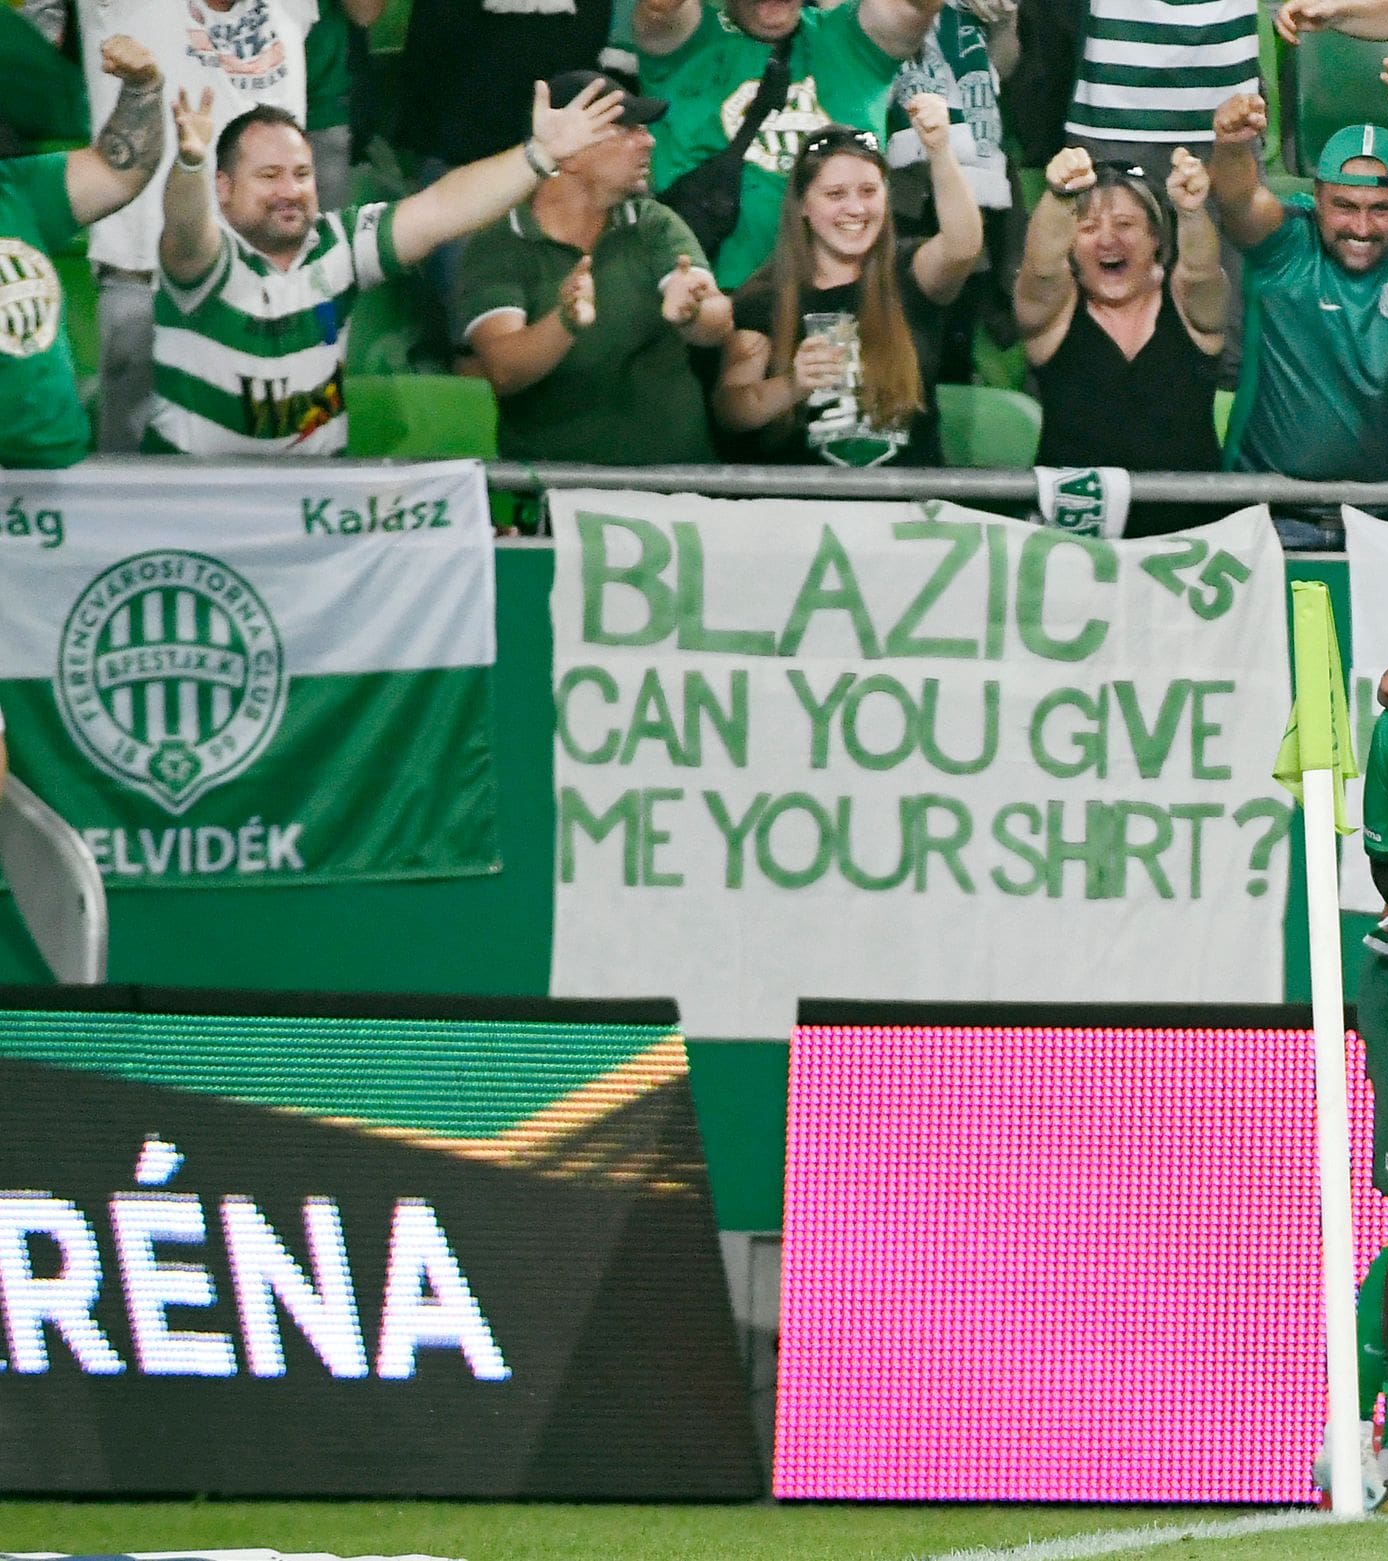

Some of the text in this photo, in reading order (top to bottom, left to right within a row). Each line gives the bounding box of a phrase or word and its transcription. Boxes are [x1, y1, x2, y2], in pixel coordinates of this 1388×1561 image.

[0, 495, 64, 549] ág
[302, 497, 451, 535] Kalász
[575, 500, 1119, 662] BLAŽIC
[1140, 536, 1252, 621] 25
[557, 666, 749, 769] CAN
[786, 670, 1000, 775] YOU
[1028, 679, 1235, 780] GIVE
[82, 816, 304, 875] ELVIDÉK
[560, 787, 684, 887] ME
[702, 793, 975, 895] YOUR
[0, 1133, 513, 1379] RÉNA
